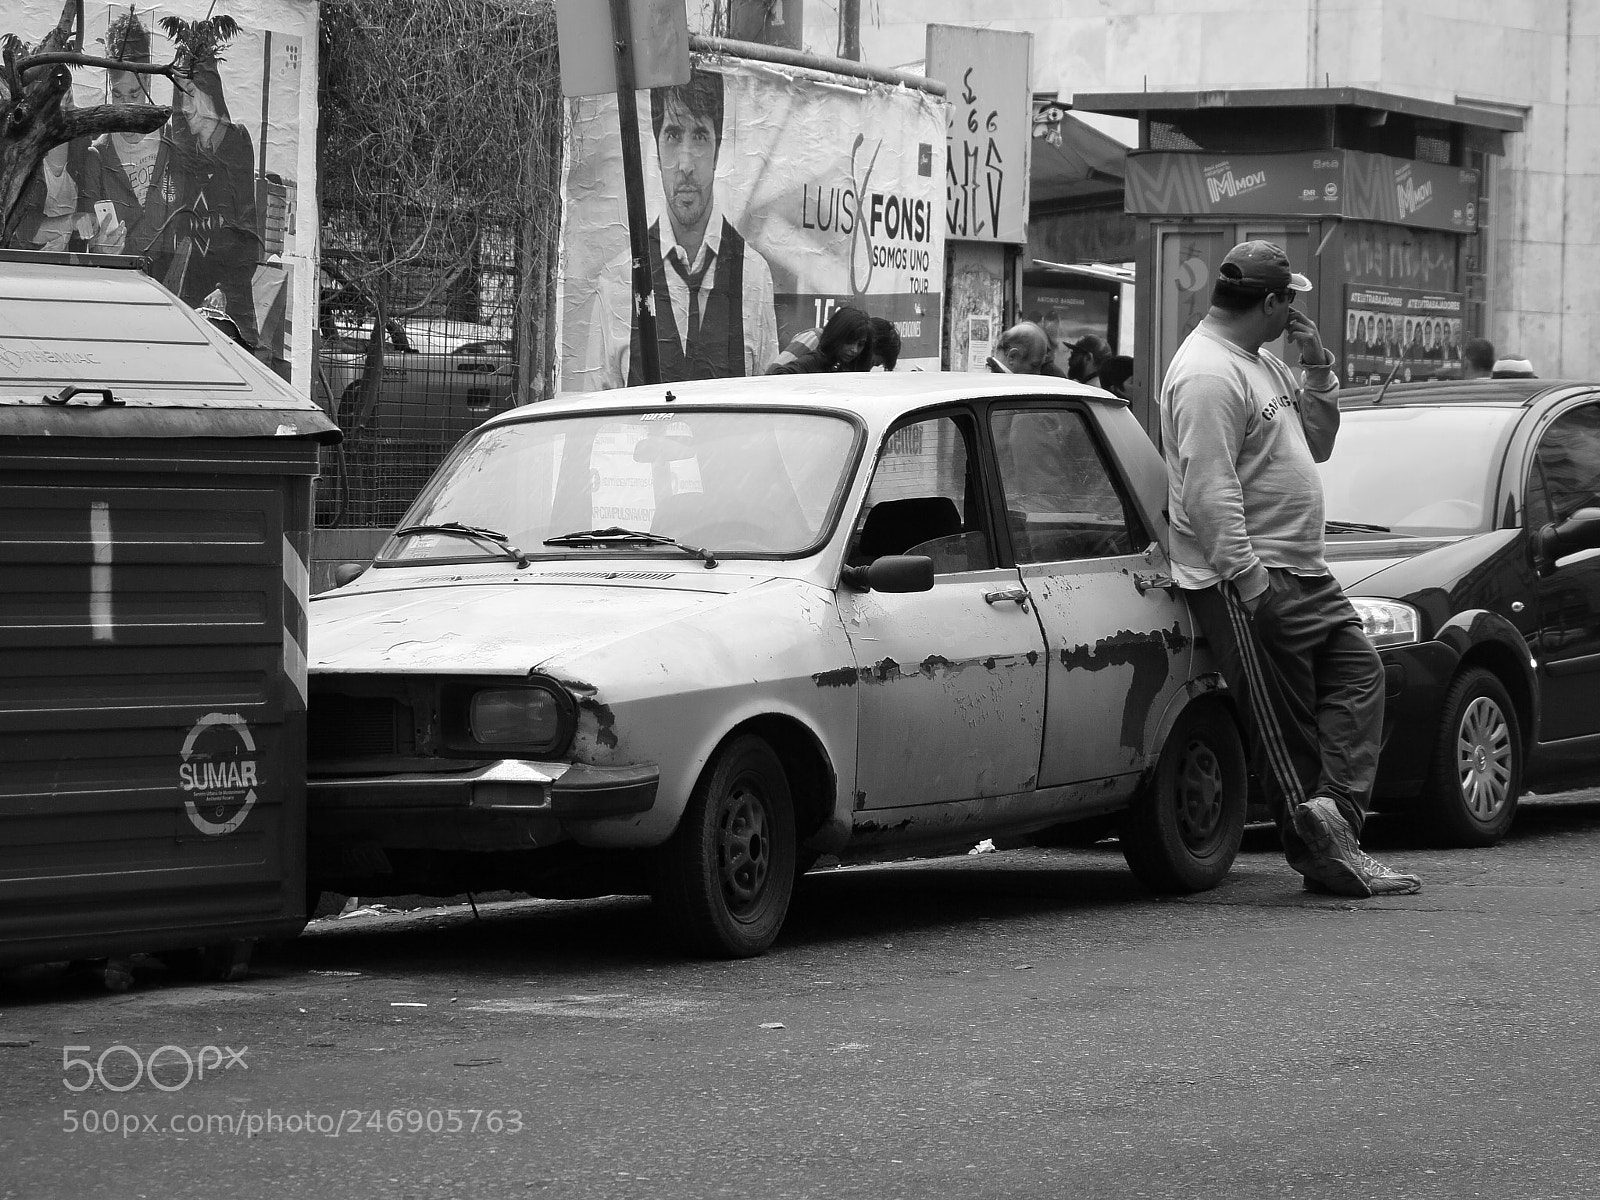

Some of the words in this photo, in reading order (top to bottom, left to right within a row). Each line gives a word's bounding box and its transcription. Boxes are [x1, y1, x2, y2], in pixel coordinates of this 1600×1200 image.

[1234, 170, 1266, 191] MOVI
[802, 183, 855, 235] LUIS
[870, 192, 931, 243] FONSI
[872, 244, 908, 270] SOMOS
[910, 249, 930, 272] UNO
[910, 276, 929, 295] TOUR
[179, 760, 258, 791] SUMAR
